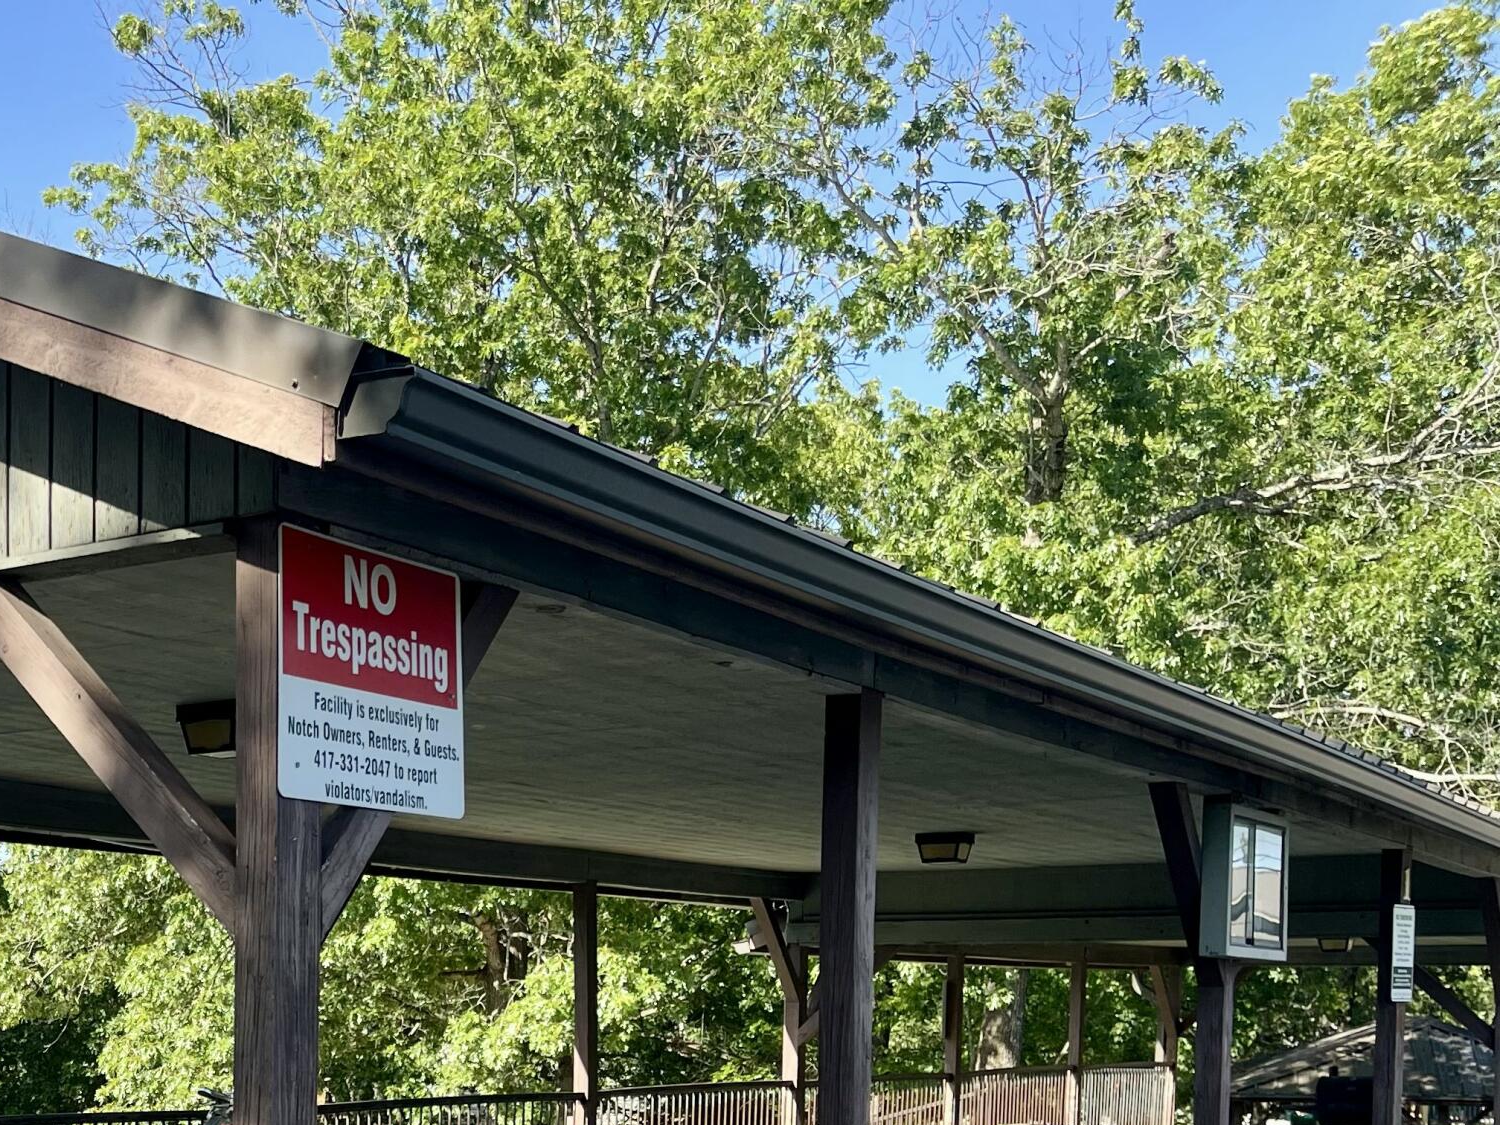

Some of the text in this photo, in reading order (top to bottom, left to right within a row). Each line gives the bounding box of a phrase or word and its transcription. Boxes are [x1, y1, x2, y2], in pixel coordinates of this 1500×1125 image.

[344, 554, 397, 616] NO
[292, 600, 449, 694] Trespassing
[314, 691, 439, 732] Facility is exclusively for
[288, 716, 460, 762] Notch Owners, Renters, & Guests.
[314, 749, 438, 786] 417-331-2047 to report
[325, 780, 428, 810] violators/vandalism.
